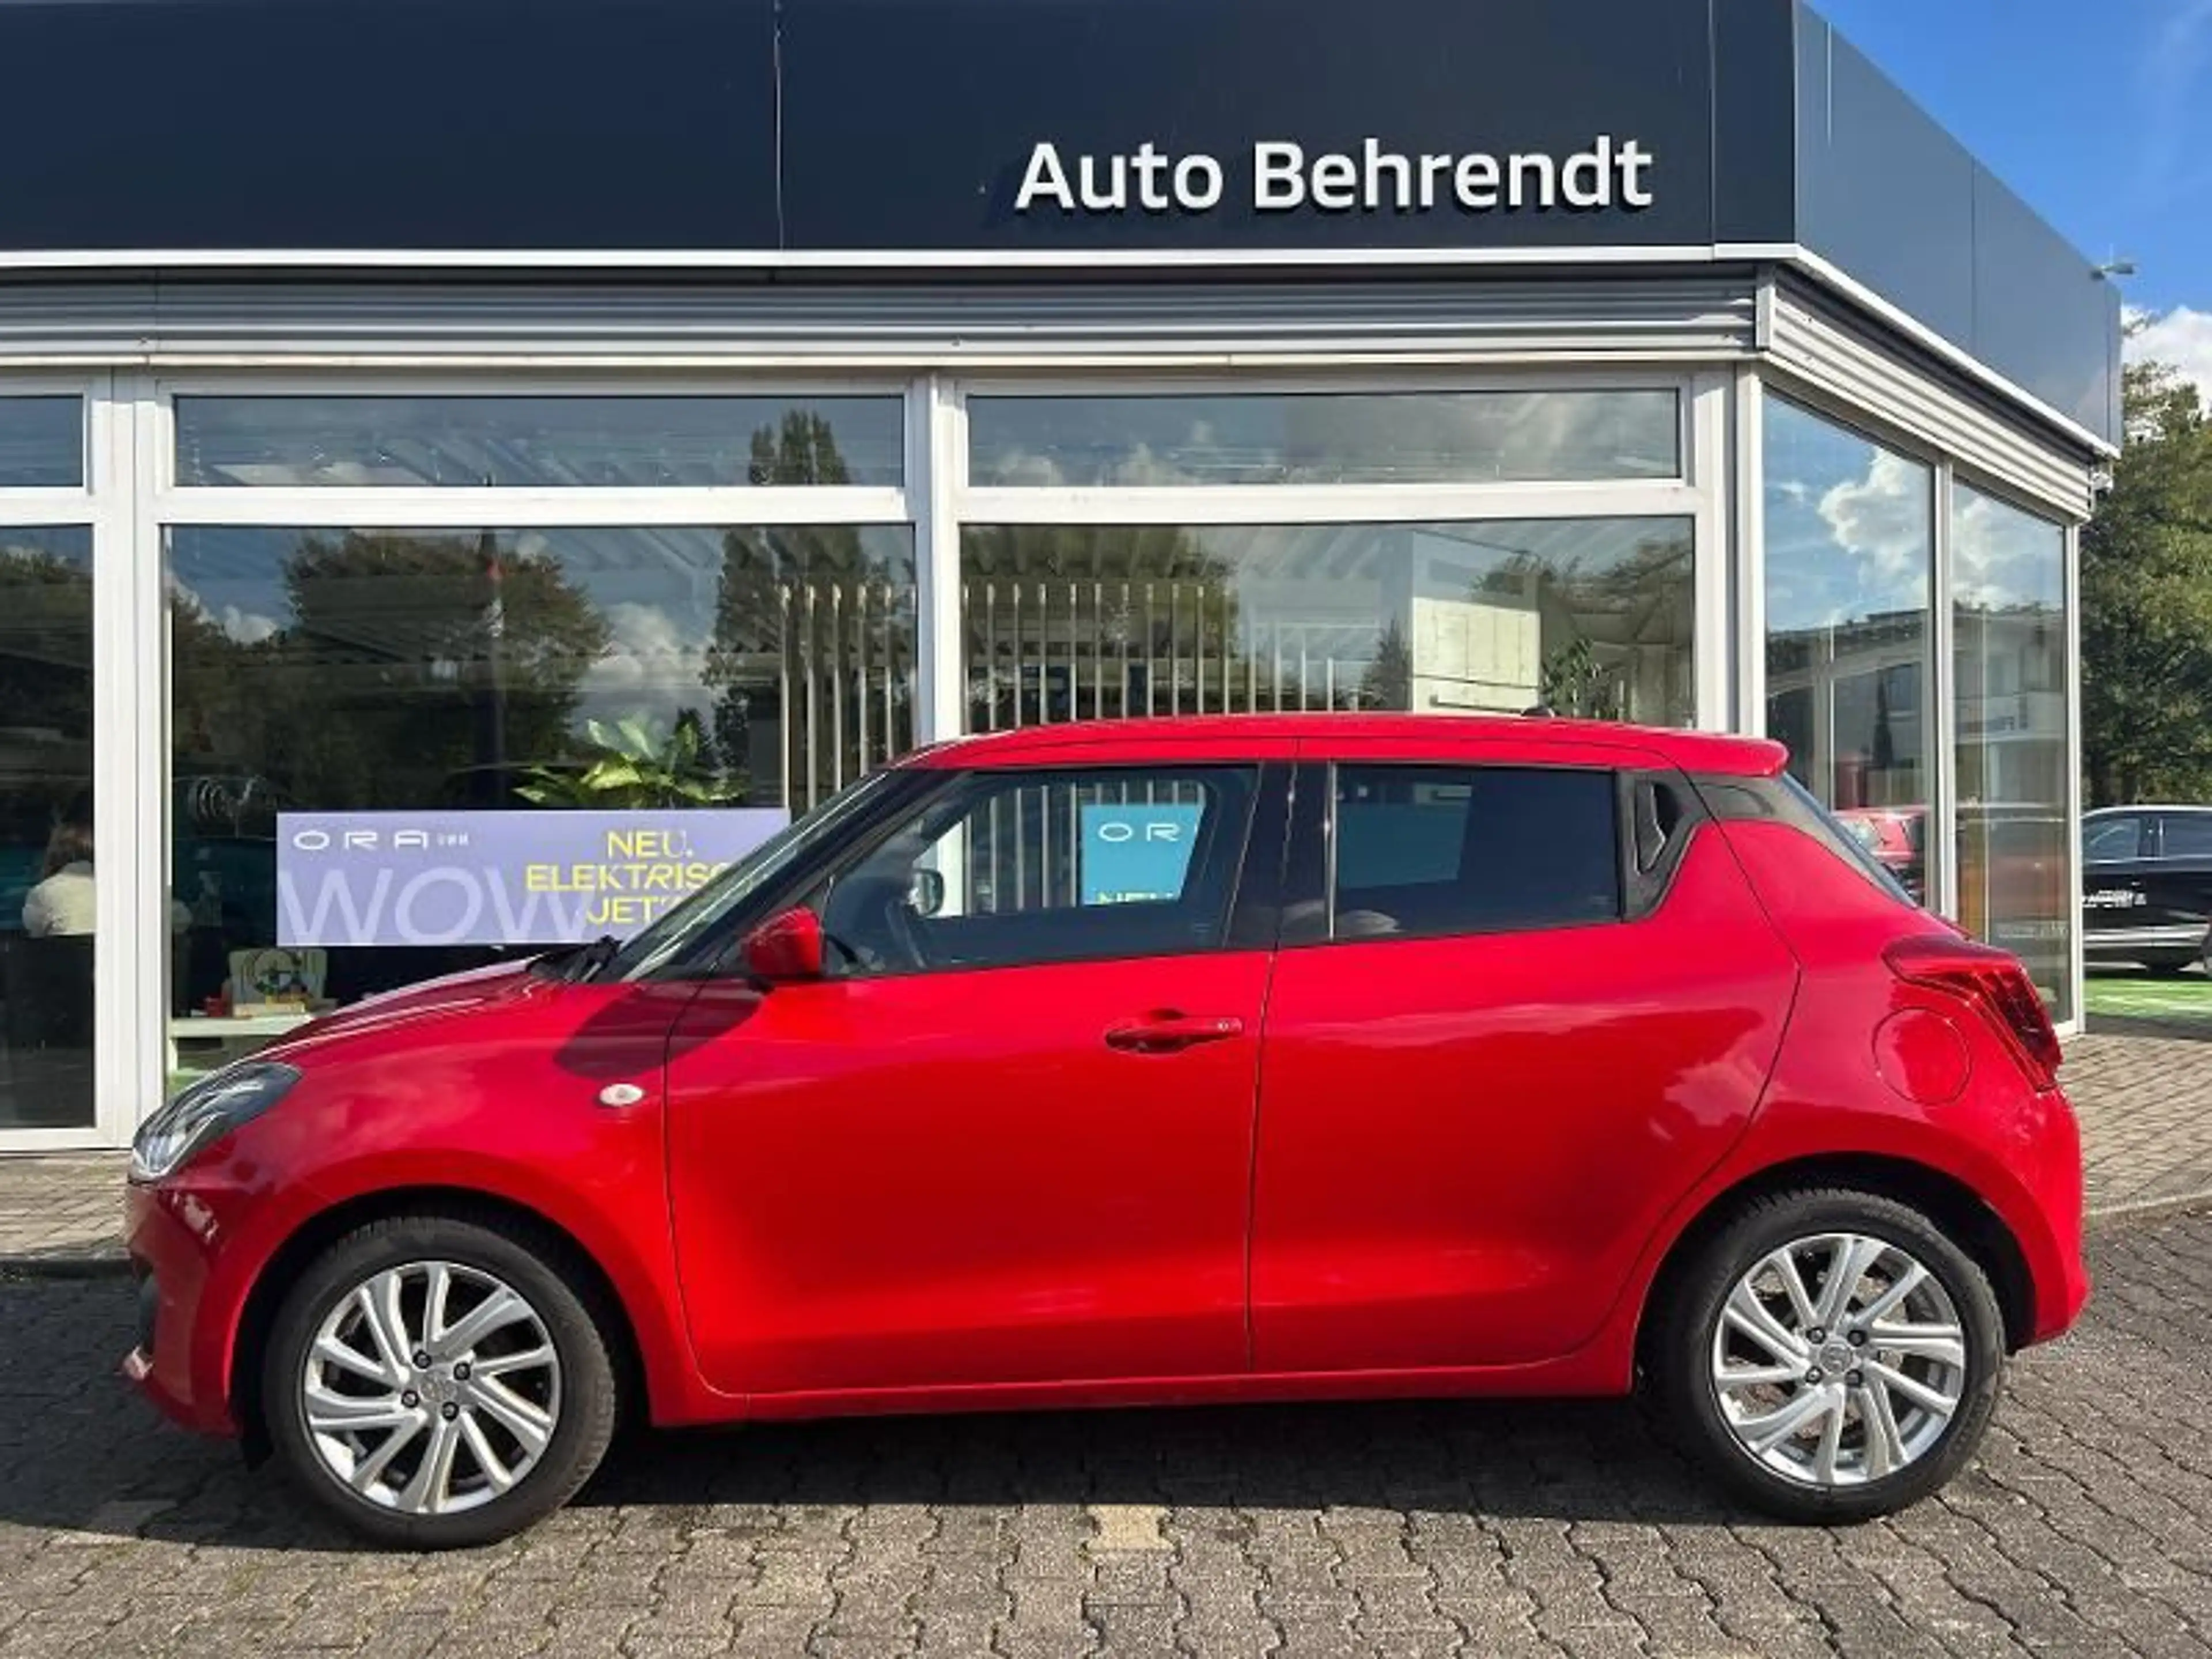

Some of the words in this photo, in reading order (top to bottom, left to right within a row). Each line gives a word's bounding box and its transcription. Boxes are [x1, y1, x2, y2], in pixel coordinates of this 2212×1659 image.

[1014, 141, 1224, 210] Auto
[1254, 135, 1653, 209] Behrendt
[293, 830, 429, 850] ORA
[607, 830, 694, 859] NEU.
[1098, 823, 1198, 842] OR
[278, 867, 600, 944] WOW
